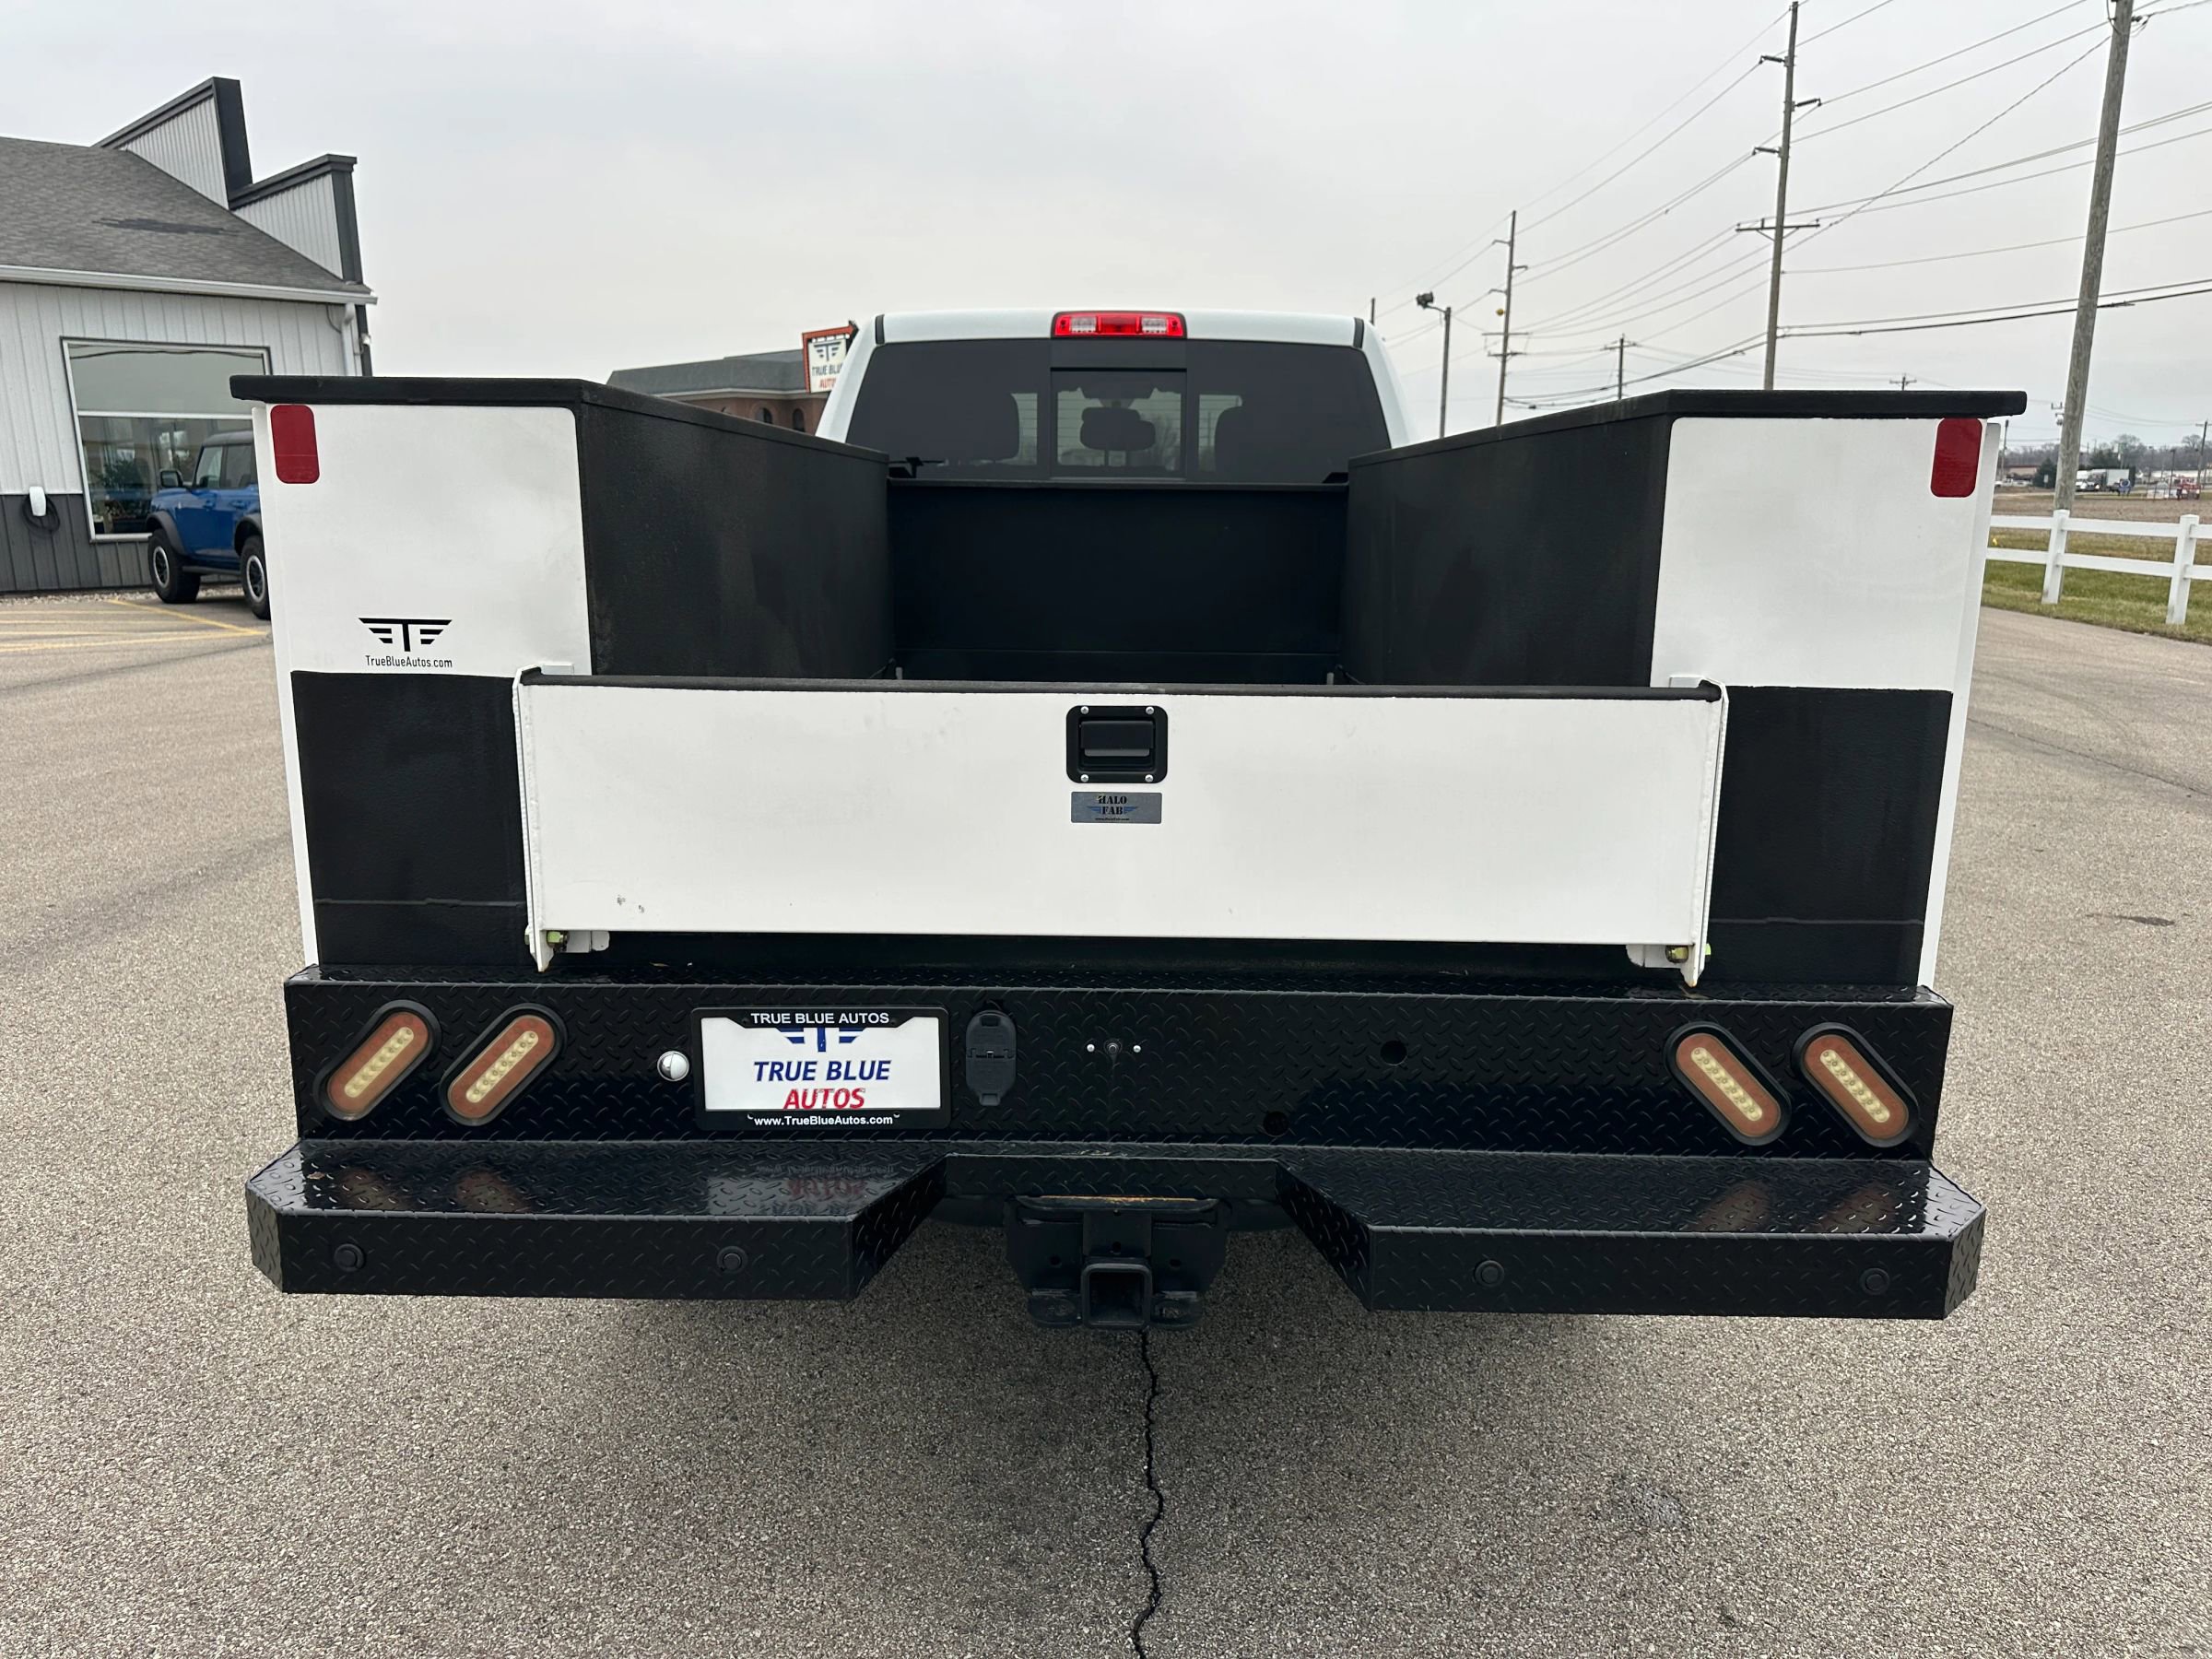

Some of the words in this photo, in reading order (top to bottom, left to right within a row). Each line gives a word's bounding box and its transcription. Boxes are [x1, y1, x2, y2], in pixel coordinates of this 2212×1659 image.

[366, 655, 453, 667] TrueBlueAutos.com
[1098, 795, 1127, 804] HALO
[1101, 806, 1124, 815] FAB
[750, 1013, 792, 1024] TRUE
[794, 1013, 835, 1024] BLUE
[839, 1012, 890, 1024] AUTOS
[753, 1061, 818, 1082] TRUE
[826, 1060, 892, 1081] BLUE
[782, 1088, 866, 1110] AUTOS
[754, 1115, 893, 1126] www.TrueBlueAutos.com
